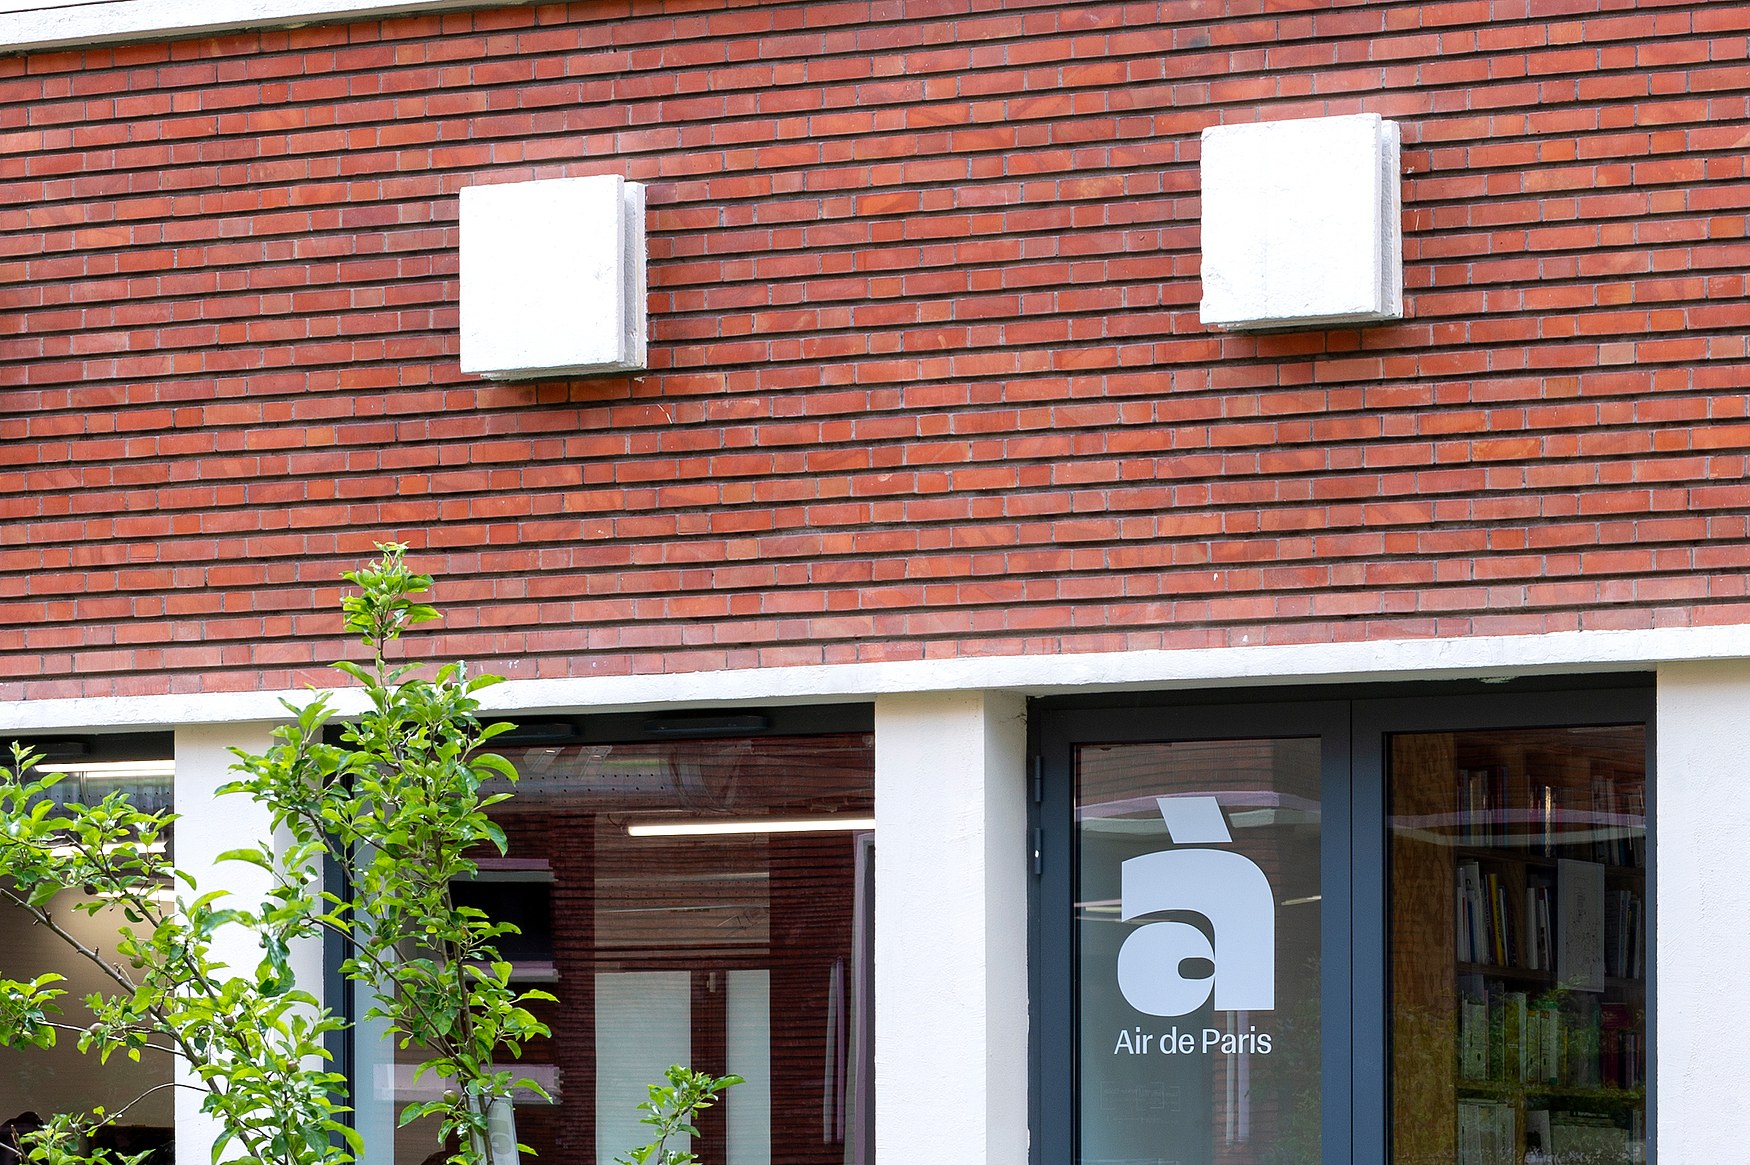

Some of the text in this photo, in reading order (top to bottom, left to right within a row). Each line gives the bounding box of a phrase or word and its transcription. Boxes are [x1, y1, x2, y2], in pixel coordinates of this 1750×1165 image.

[1114, 1025, 1272, 1055] Air de Paris
